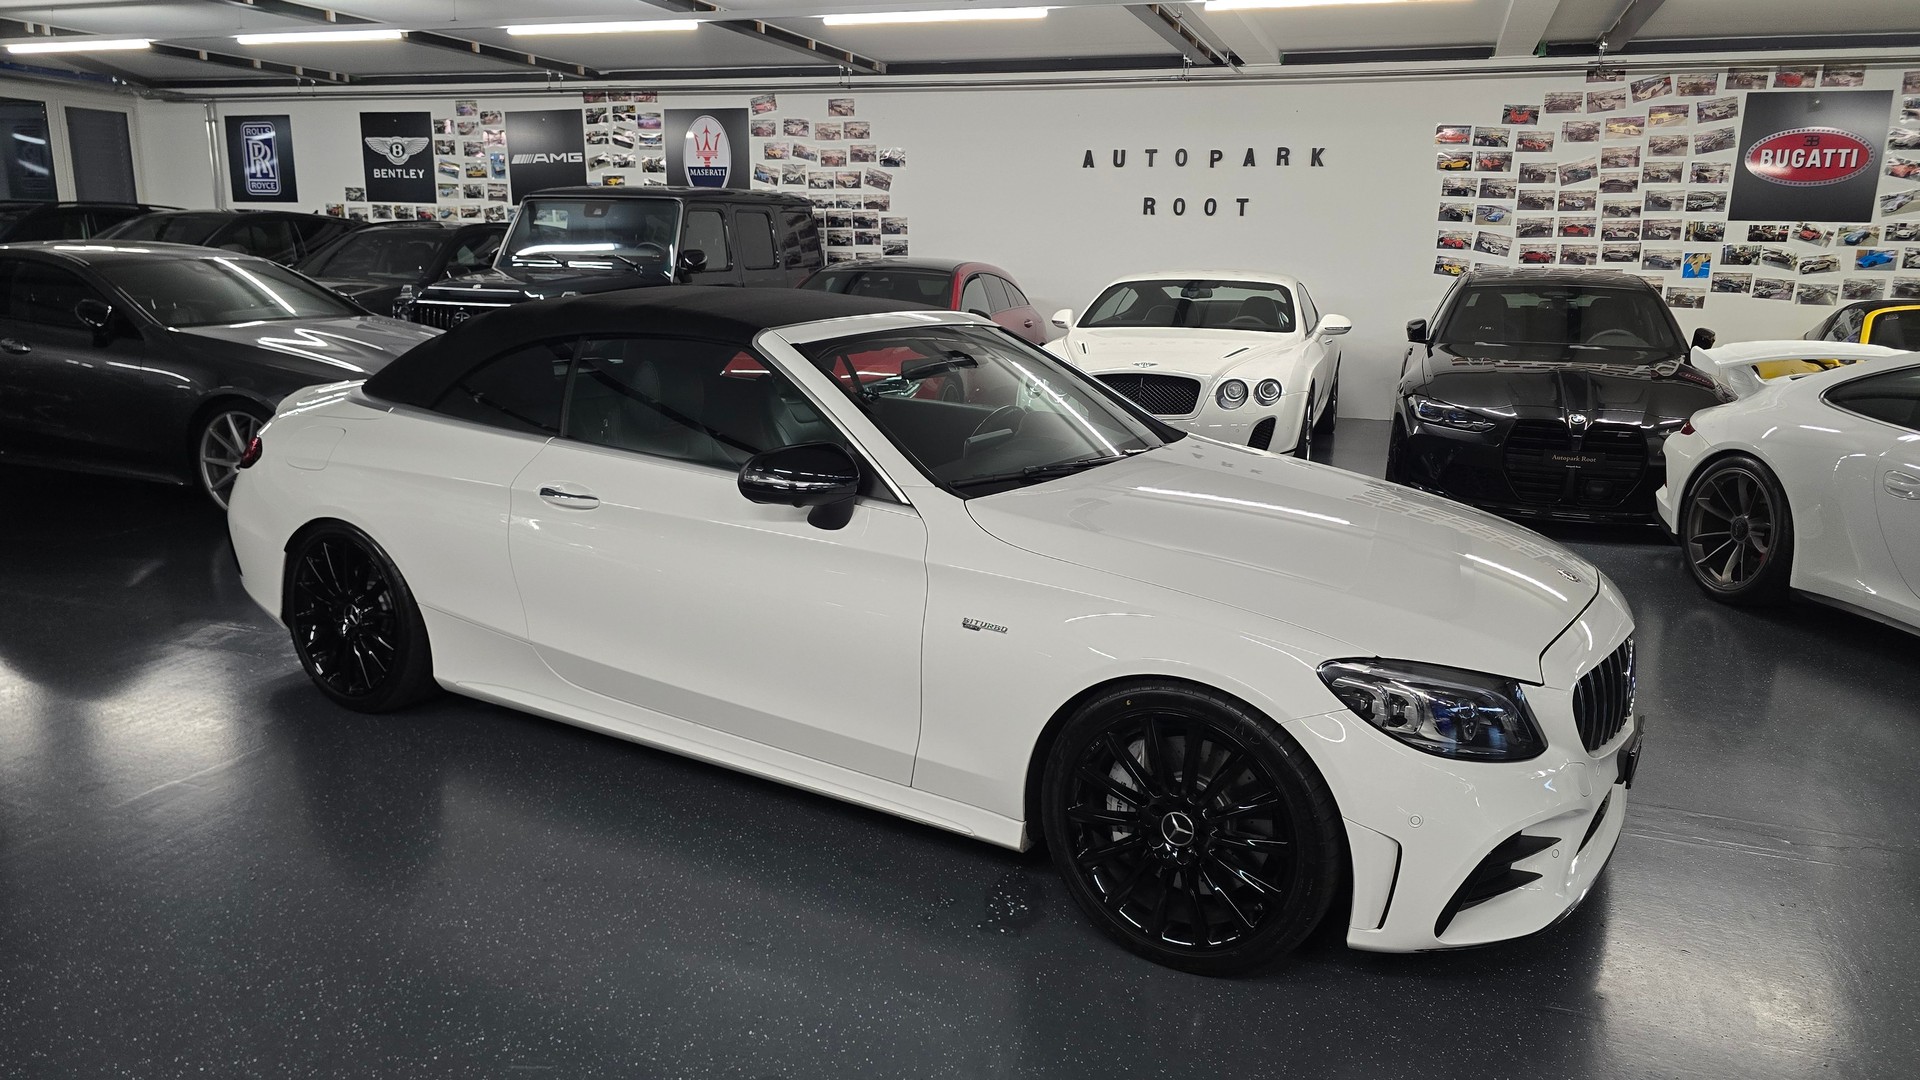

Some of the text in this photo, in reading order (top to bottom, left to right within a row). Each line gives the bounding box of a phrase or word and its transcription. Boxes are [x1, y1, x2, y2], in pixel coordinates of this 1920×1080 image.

[245, 127, 270, 136] ROLLS
[532, 152, 583, 164] AMG
[1082, 147, 1326, 168] AUTOPARK
[1759, 148, 1859, 168] BUGATTI
[373, 168, 425, 178] BENTLEY
[690, 168, 725, 176] MASERATI
[251, 181, 276, 190] ROYCE
[1142, 197, 1250, 216] ROOT
[1551, 454, 1597, 463] Autopark Root
[962, 617, 1008, 633] BITURBO
